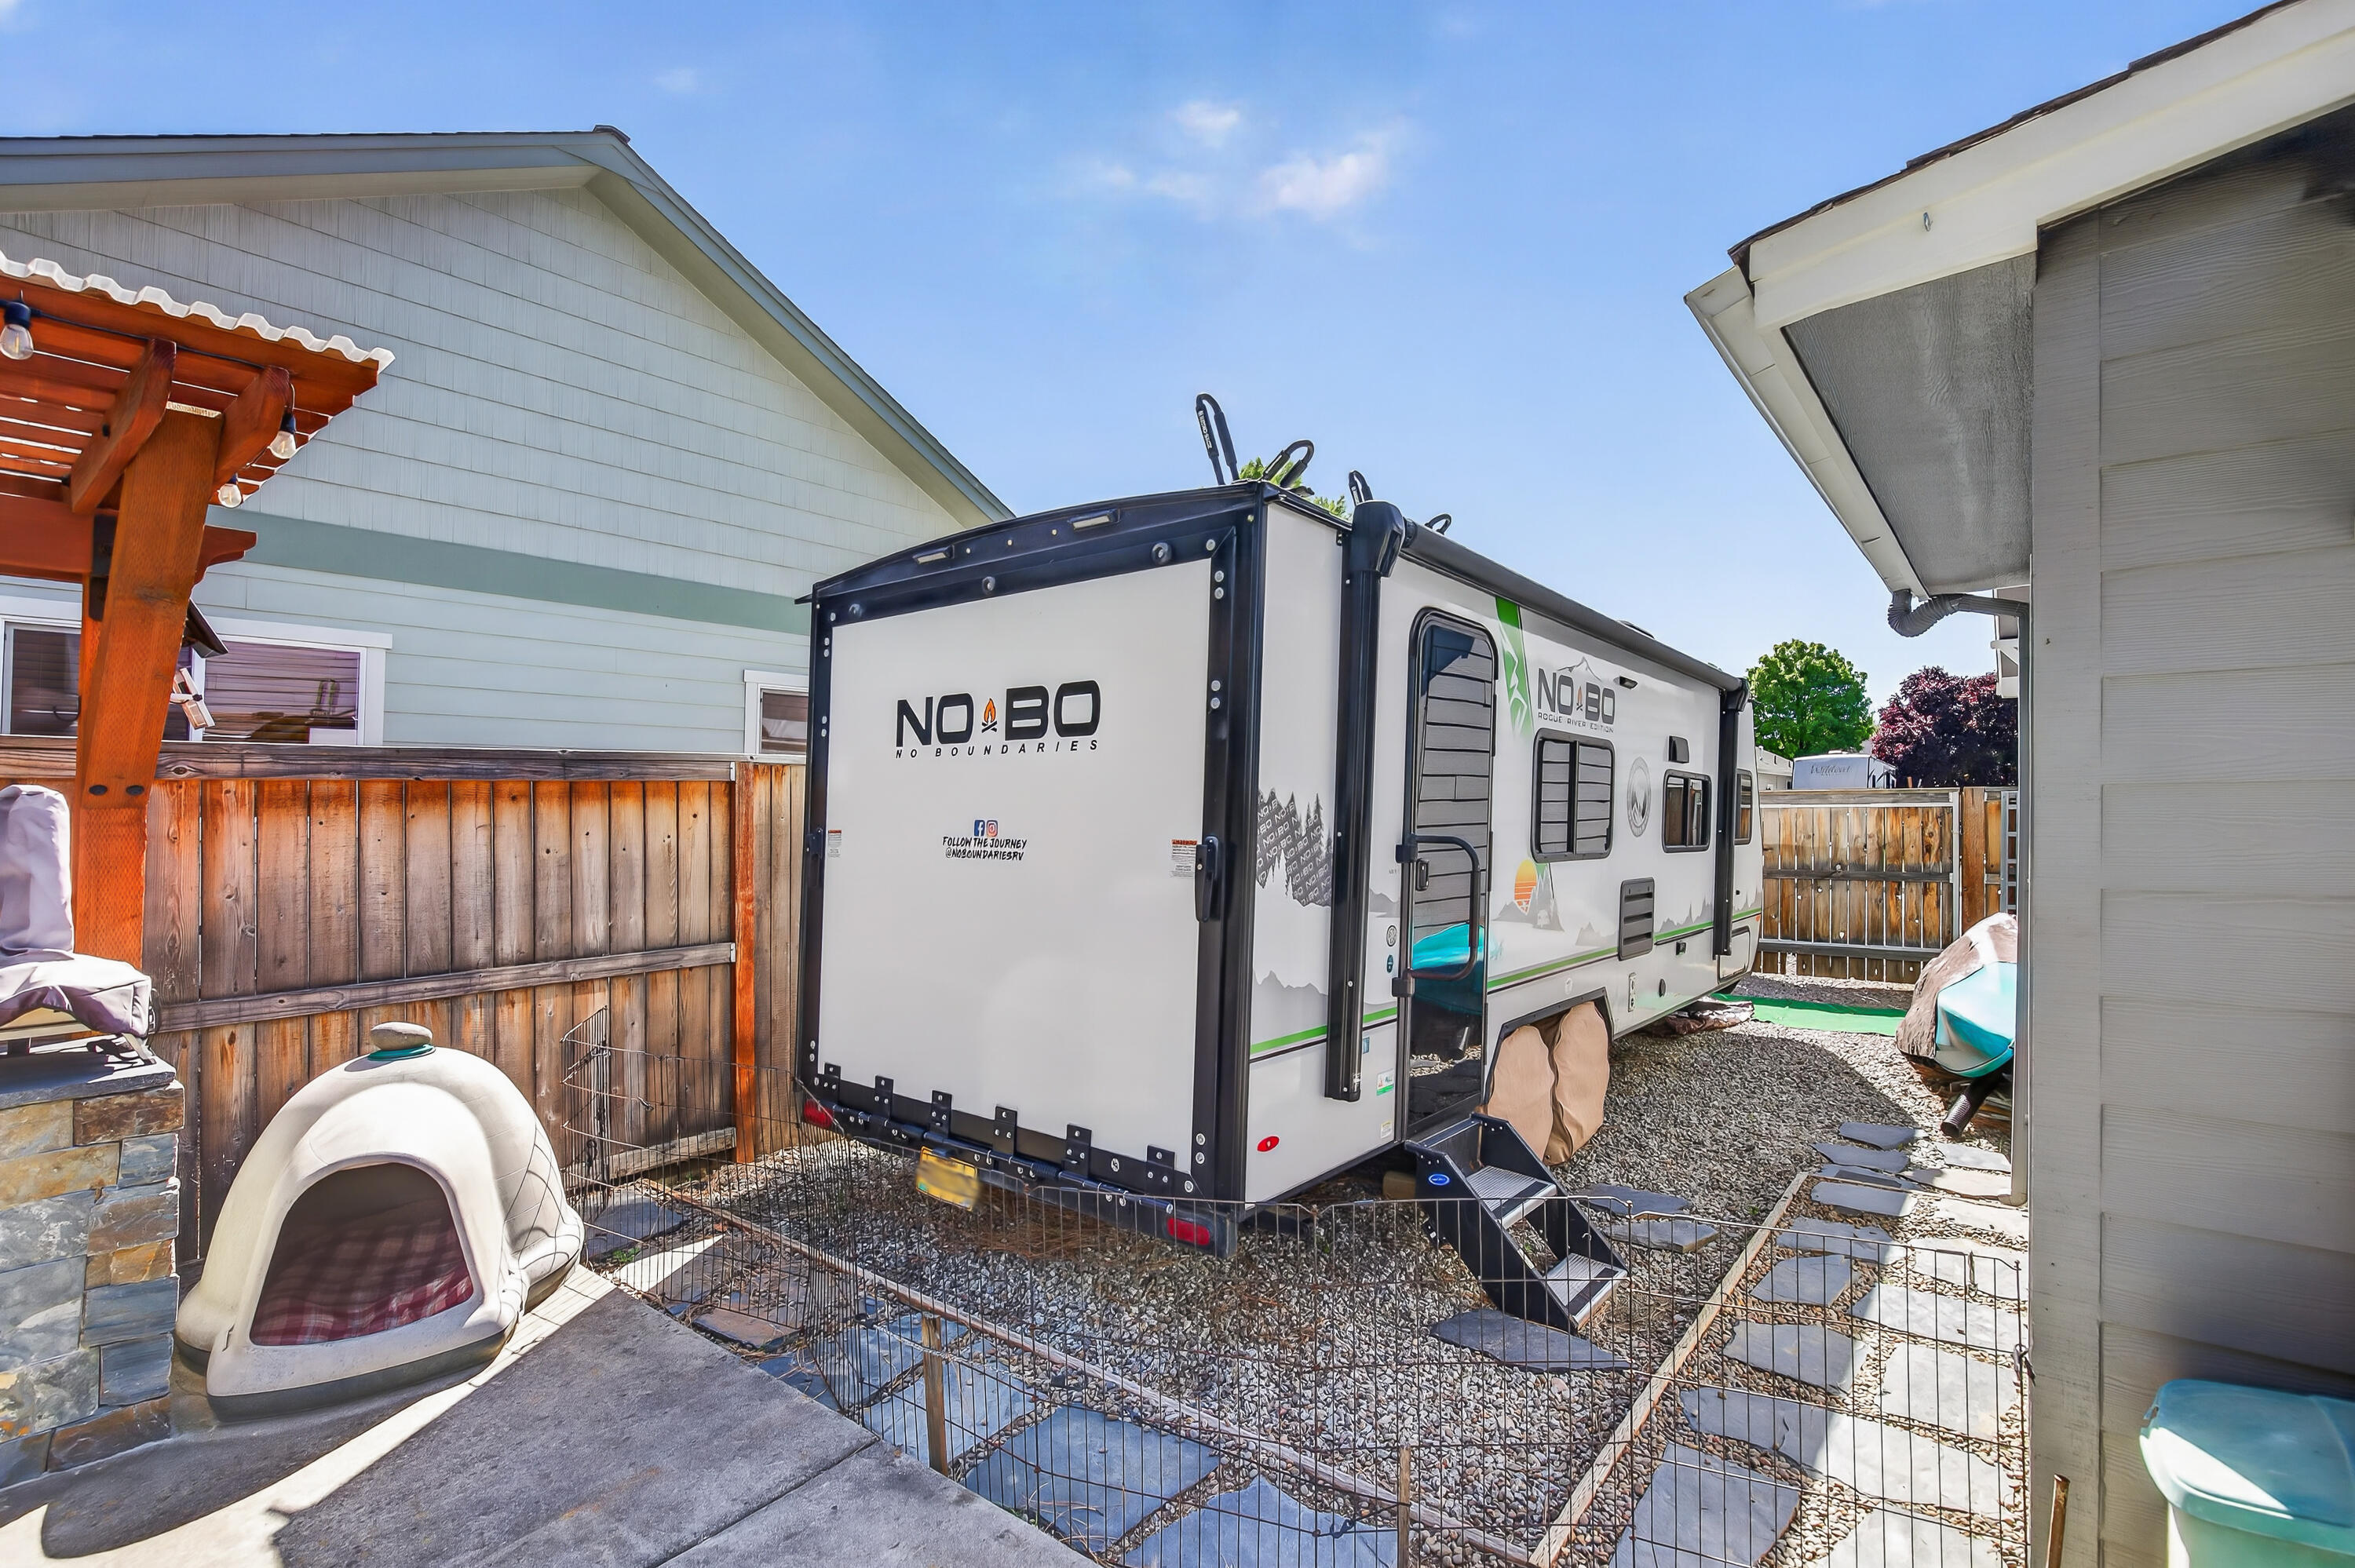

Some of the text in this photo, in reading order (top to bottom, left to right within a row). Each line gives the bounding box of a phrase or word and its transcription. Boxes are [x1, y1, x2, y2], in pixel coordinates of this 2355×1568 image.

[1538, 713, 1614, 733] ROGUE RIVER EDITION
[896, 740, 1097, 759] NO BOUNDARIES
[942, 836, 1028, 850] FOLLOW THE JOURNEY
[945, 847, 1024, 861] @NOBOUNDARIESRV
